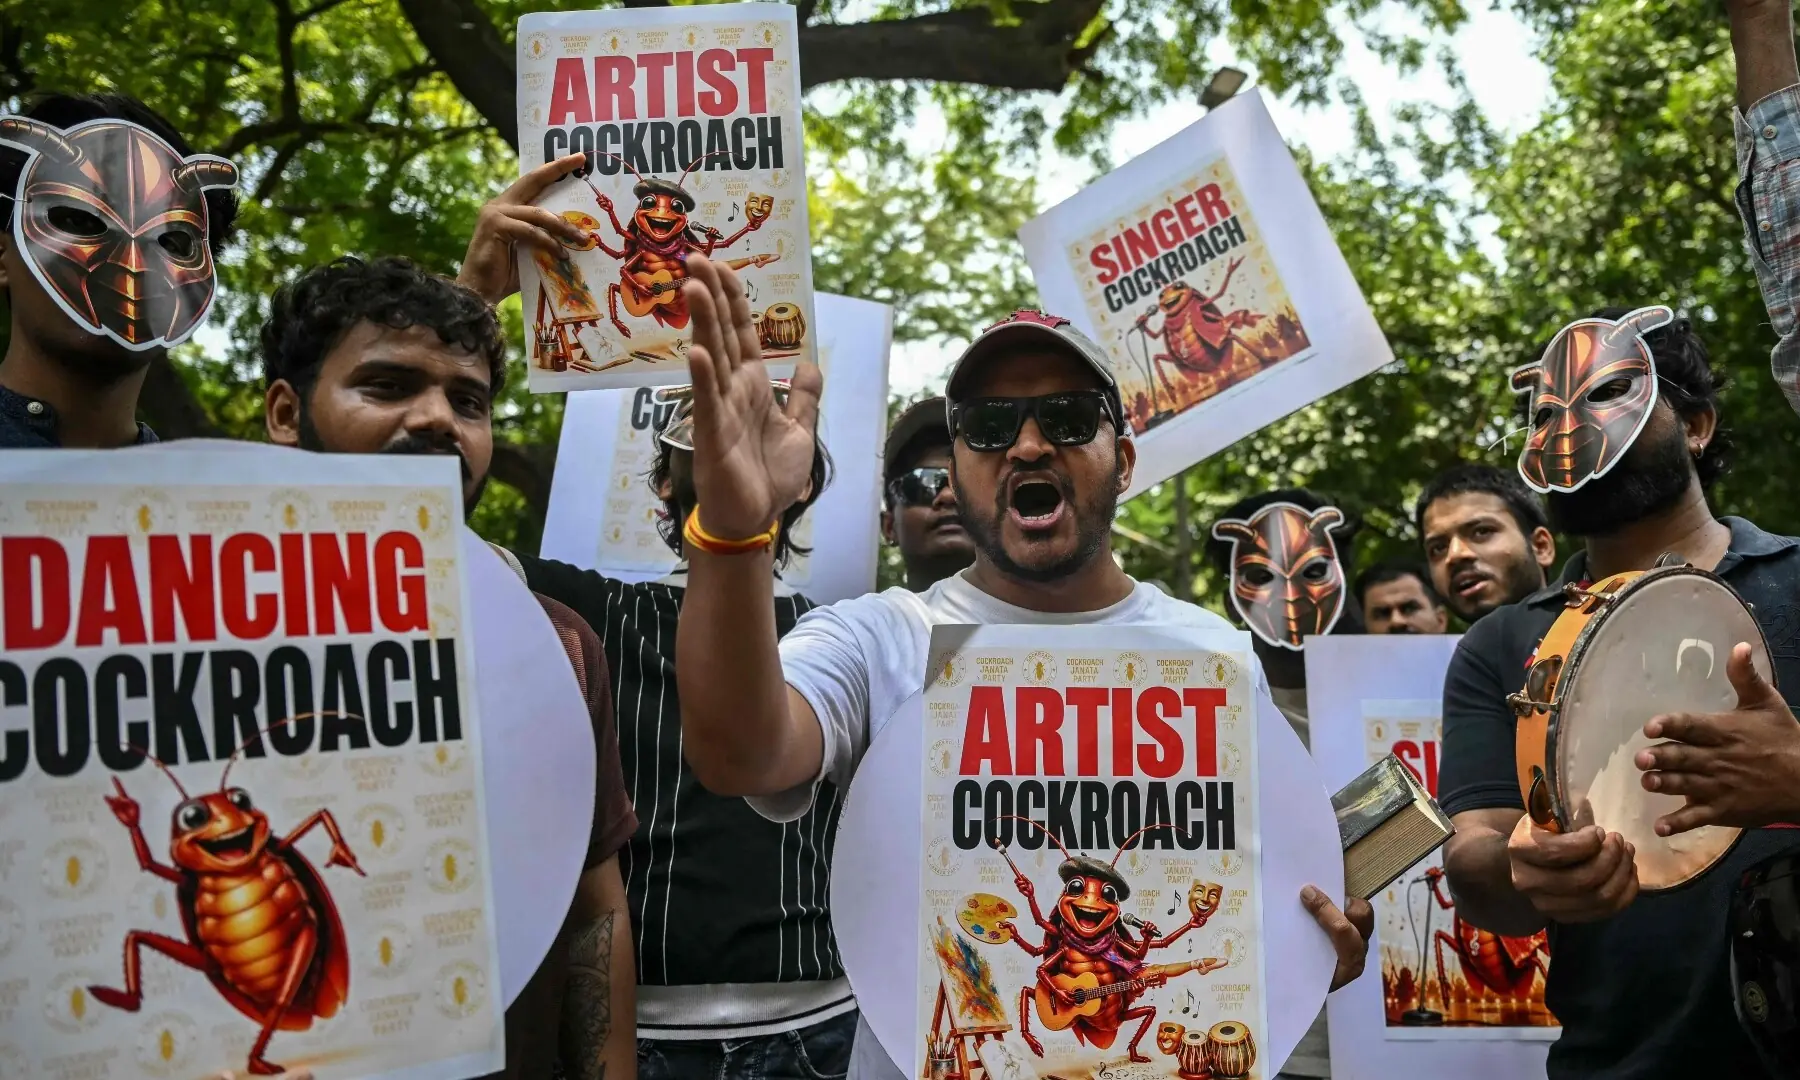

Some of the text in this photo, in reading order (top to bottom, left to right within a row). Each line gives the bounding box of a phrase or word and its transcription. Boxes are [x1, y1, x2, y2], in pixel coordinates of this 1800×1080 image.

[548, 48, 773, 126] ARTIST
[543, 116, 784, 183] COCKROACH
[1089, 182, 1231, 285] SINGER
[1103, 215, 1247, 314] COCKROACH
[2, 531, 429, 650] DANCING
[976, 657, 1014, 666] COCKROACH
[1066, 658, 1104, 667] COCKROACH
[1156, 659, 1194, 668] COCKROACH
[980, 665, 1009, 674] JANATA
[1071, 666, 1098, 675] JANATA
[1160, 667, 1189, 676] JANATA
[982, 674, 1006, 682] PARTY
[1073, 675, 1097, 684] PARTY
[1163, 676, 1187, 684] PARTY
[958, 686, 1227, 778] ARTIST
[952, 779, 1236, 851] COCKROACH
[1164, 866, 1193, 876] JANATA
[1167, 875, 1191, 884] PARTY
